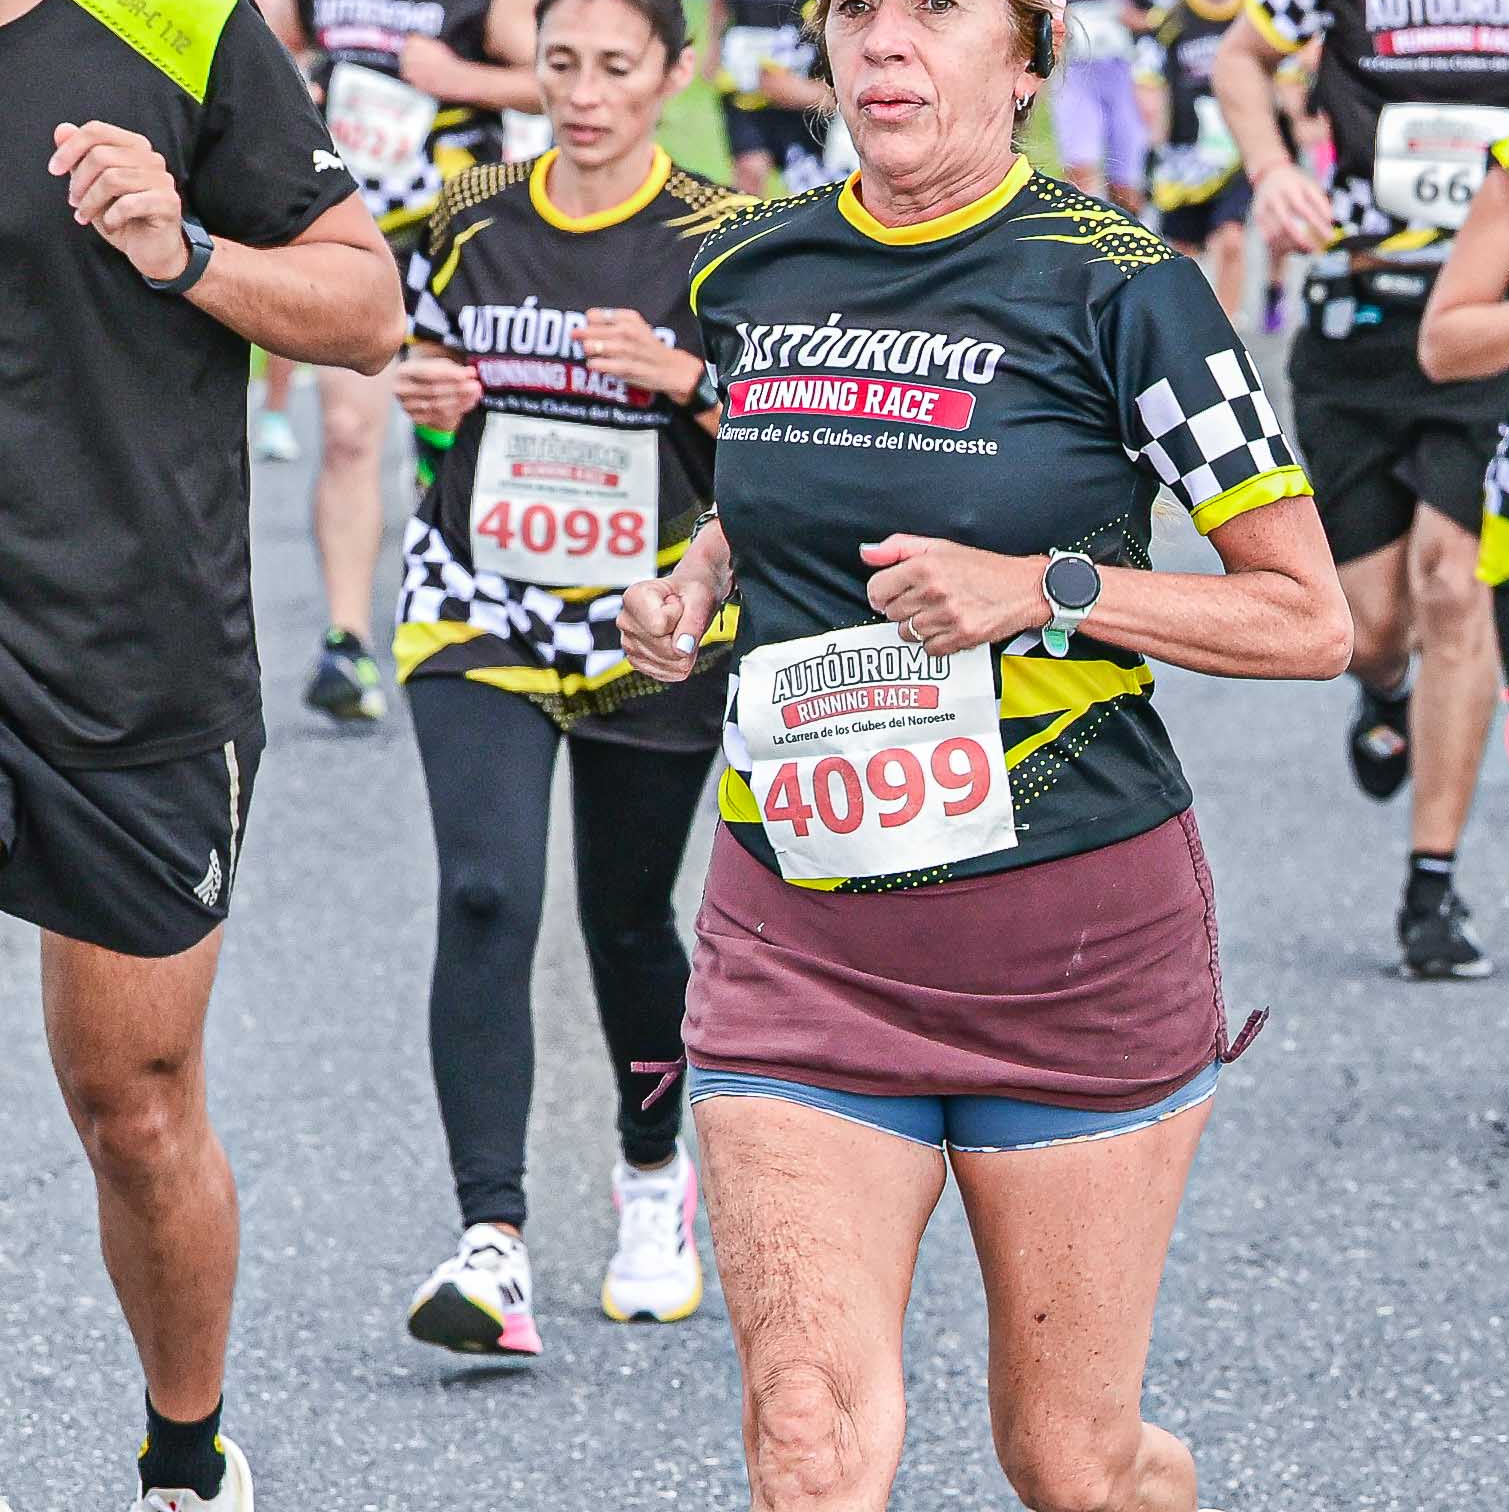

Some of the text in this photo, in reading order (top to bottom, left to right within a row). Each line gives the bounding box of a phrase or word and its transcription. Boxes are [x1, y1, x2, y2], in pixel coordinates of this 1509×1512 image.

[1415, 166, 1474, 204] 66
[731, 313, 1005, 384] AUTÓDROMO
[744, 380, 940, 422] RUNNING RACE
[720, 423, 759, 441] Carrera
[761, 424, 781, 441] de
[784, 425, 809, 443] los
[813, 428, 873, 448] Clubes
[875, 432, 904, 449] del
[908, 433, 998, 455] Noroeste
[477, 501, 646, 557] 4098
[772, 644, 950, 704] AUTÓDROMO
[797, 688, 919, 723] RUNNING RACE
[773, 712, 956, 745] La Carrera de los Clubes del Noroeste
[764, 737, 991, 837] 4099
